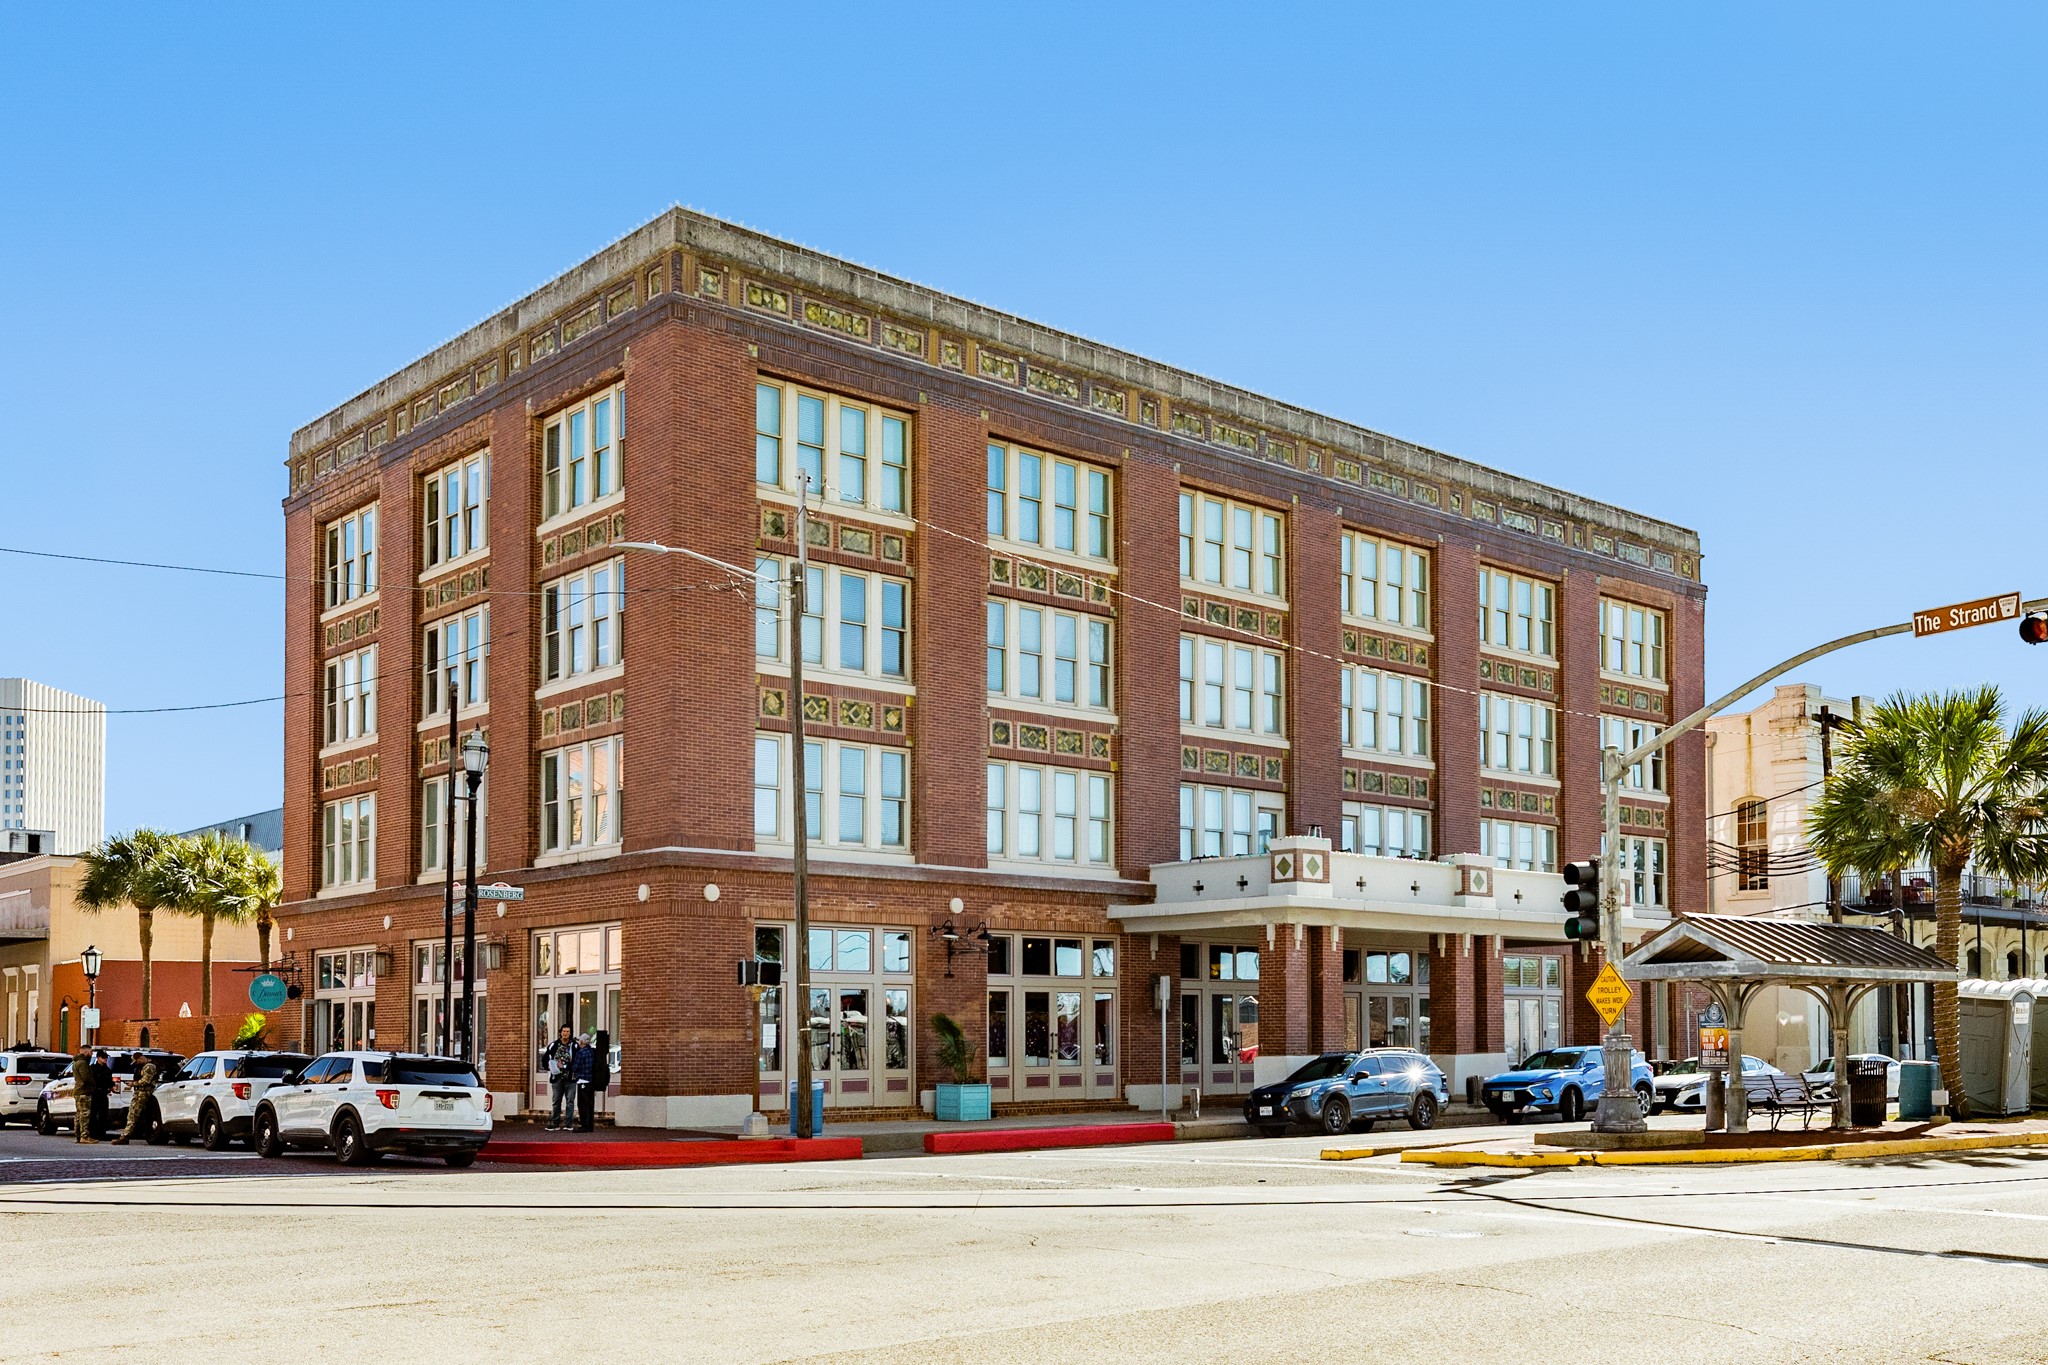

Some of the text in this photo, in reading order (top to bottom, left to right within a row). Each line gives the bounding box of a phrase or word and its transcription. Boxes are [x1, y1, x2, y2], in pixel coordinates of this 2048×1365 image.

[1915, 615, 1941, 633] The
[1949, 601, 1998, 627] Strand
[478, 889, 523, 899] ROSENBERG
[1597, 986, 1622, 994] TROLLEY
[1612, 996, 1624, 1004] WIDE
